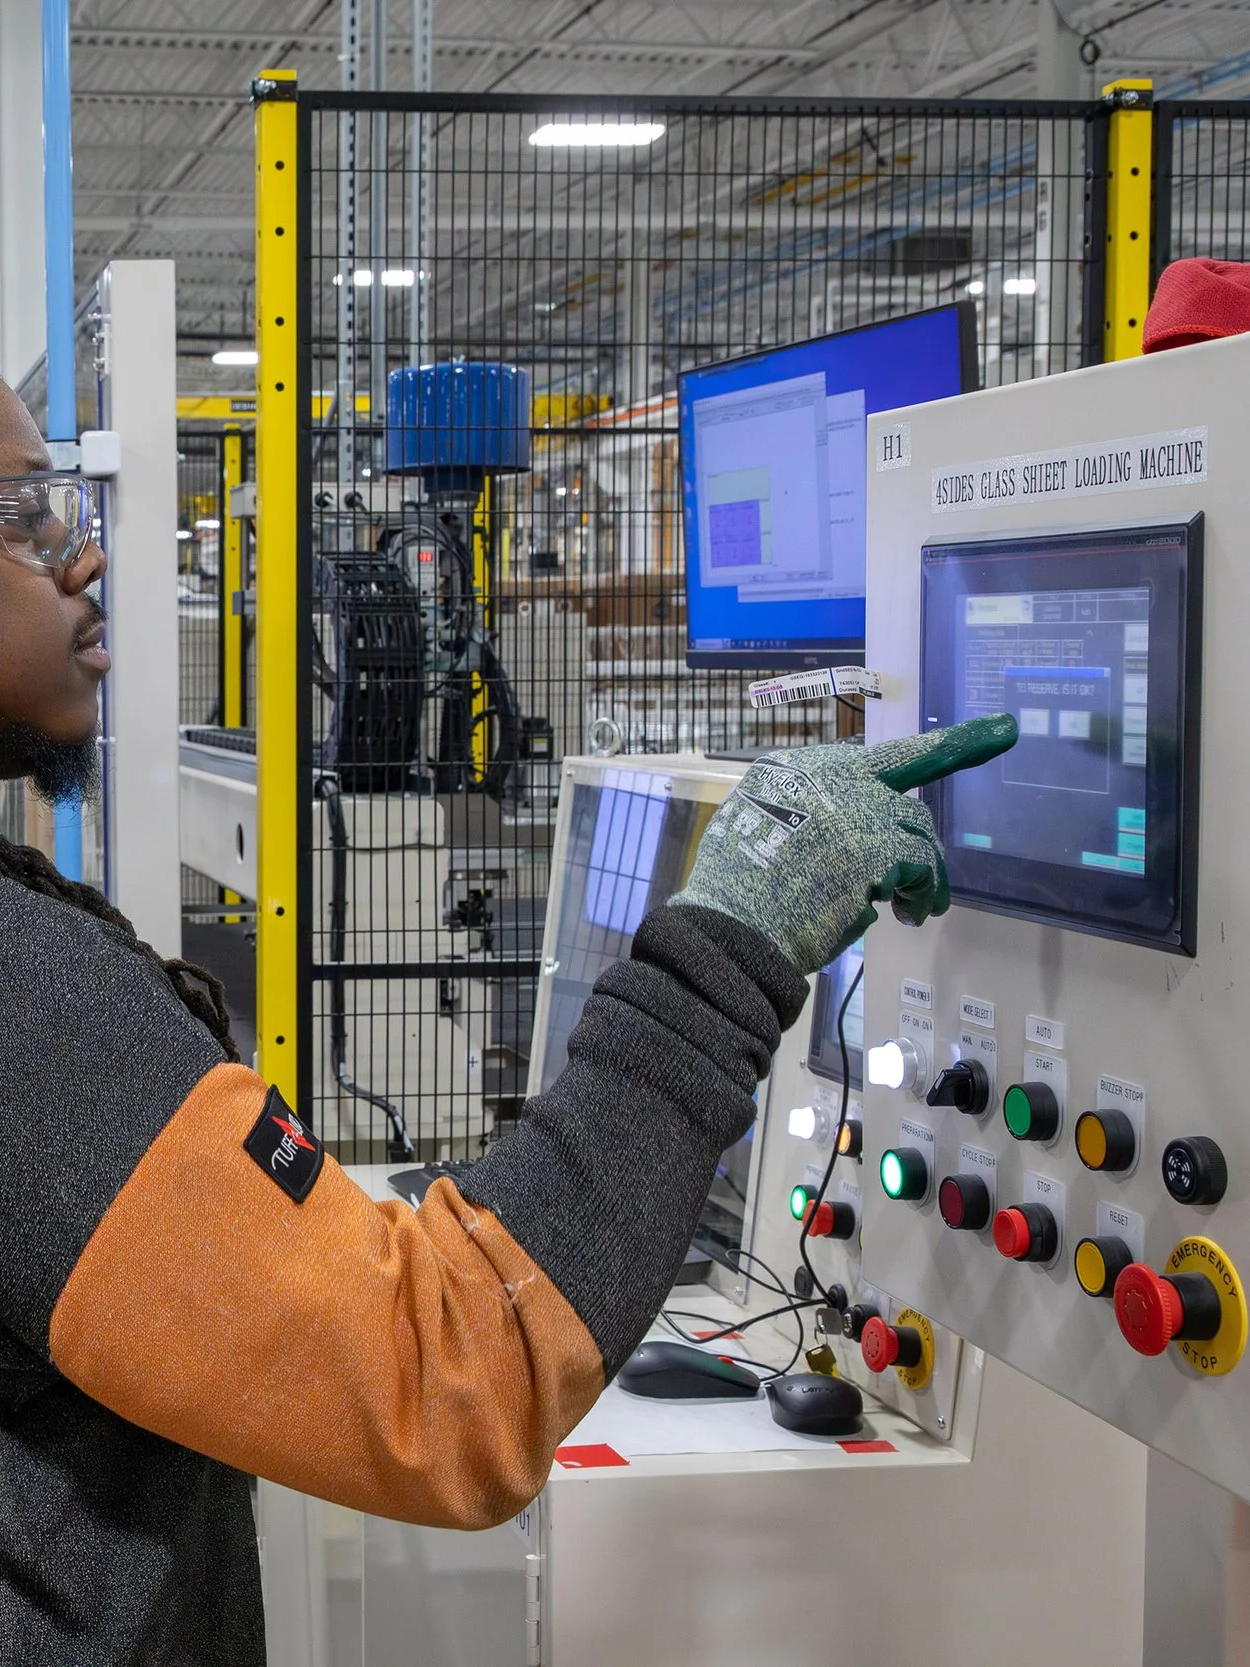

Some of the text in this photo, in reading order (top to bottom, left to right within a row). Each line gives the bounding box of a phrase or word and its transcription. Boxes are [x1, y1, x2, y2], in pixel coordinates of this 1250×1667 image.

[883, 434, 903, 461] H1
[936, 440, 1203, 504] 4SIDES GLASS SHIEET LOADING MACHINE
[759, 767, 801, 798] HyFlex
[788, 814, 800, 826] 10
[963, 1004, 974, 1016] MODE
[1036, 1026, 1052, 1039] AUTO
[1035, 1058, 1053, 1072] START
[1100, 1079, 1123, 1097] BUZZER
[962, 1148, 978, 1163] CYCLE
[1037, 1180, 1051, 1193] STOP
[1110, 1210, 1128, 1226] RESET
[1171, 1242, 1238, 1298] EMERGENCY
[1182, 1342, 1218, 1369] STOP
